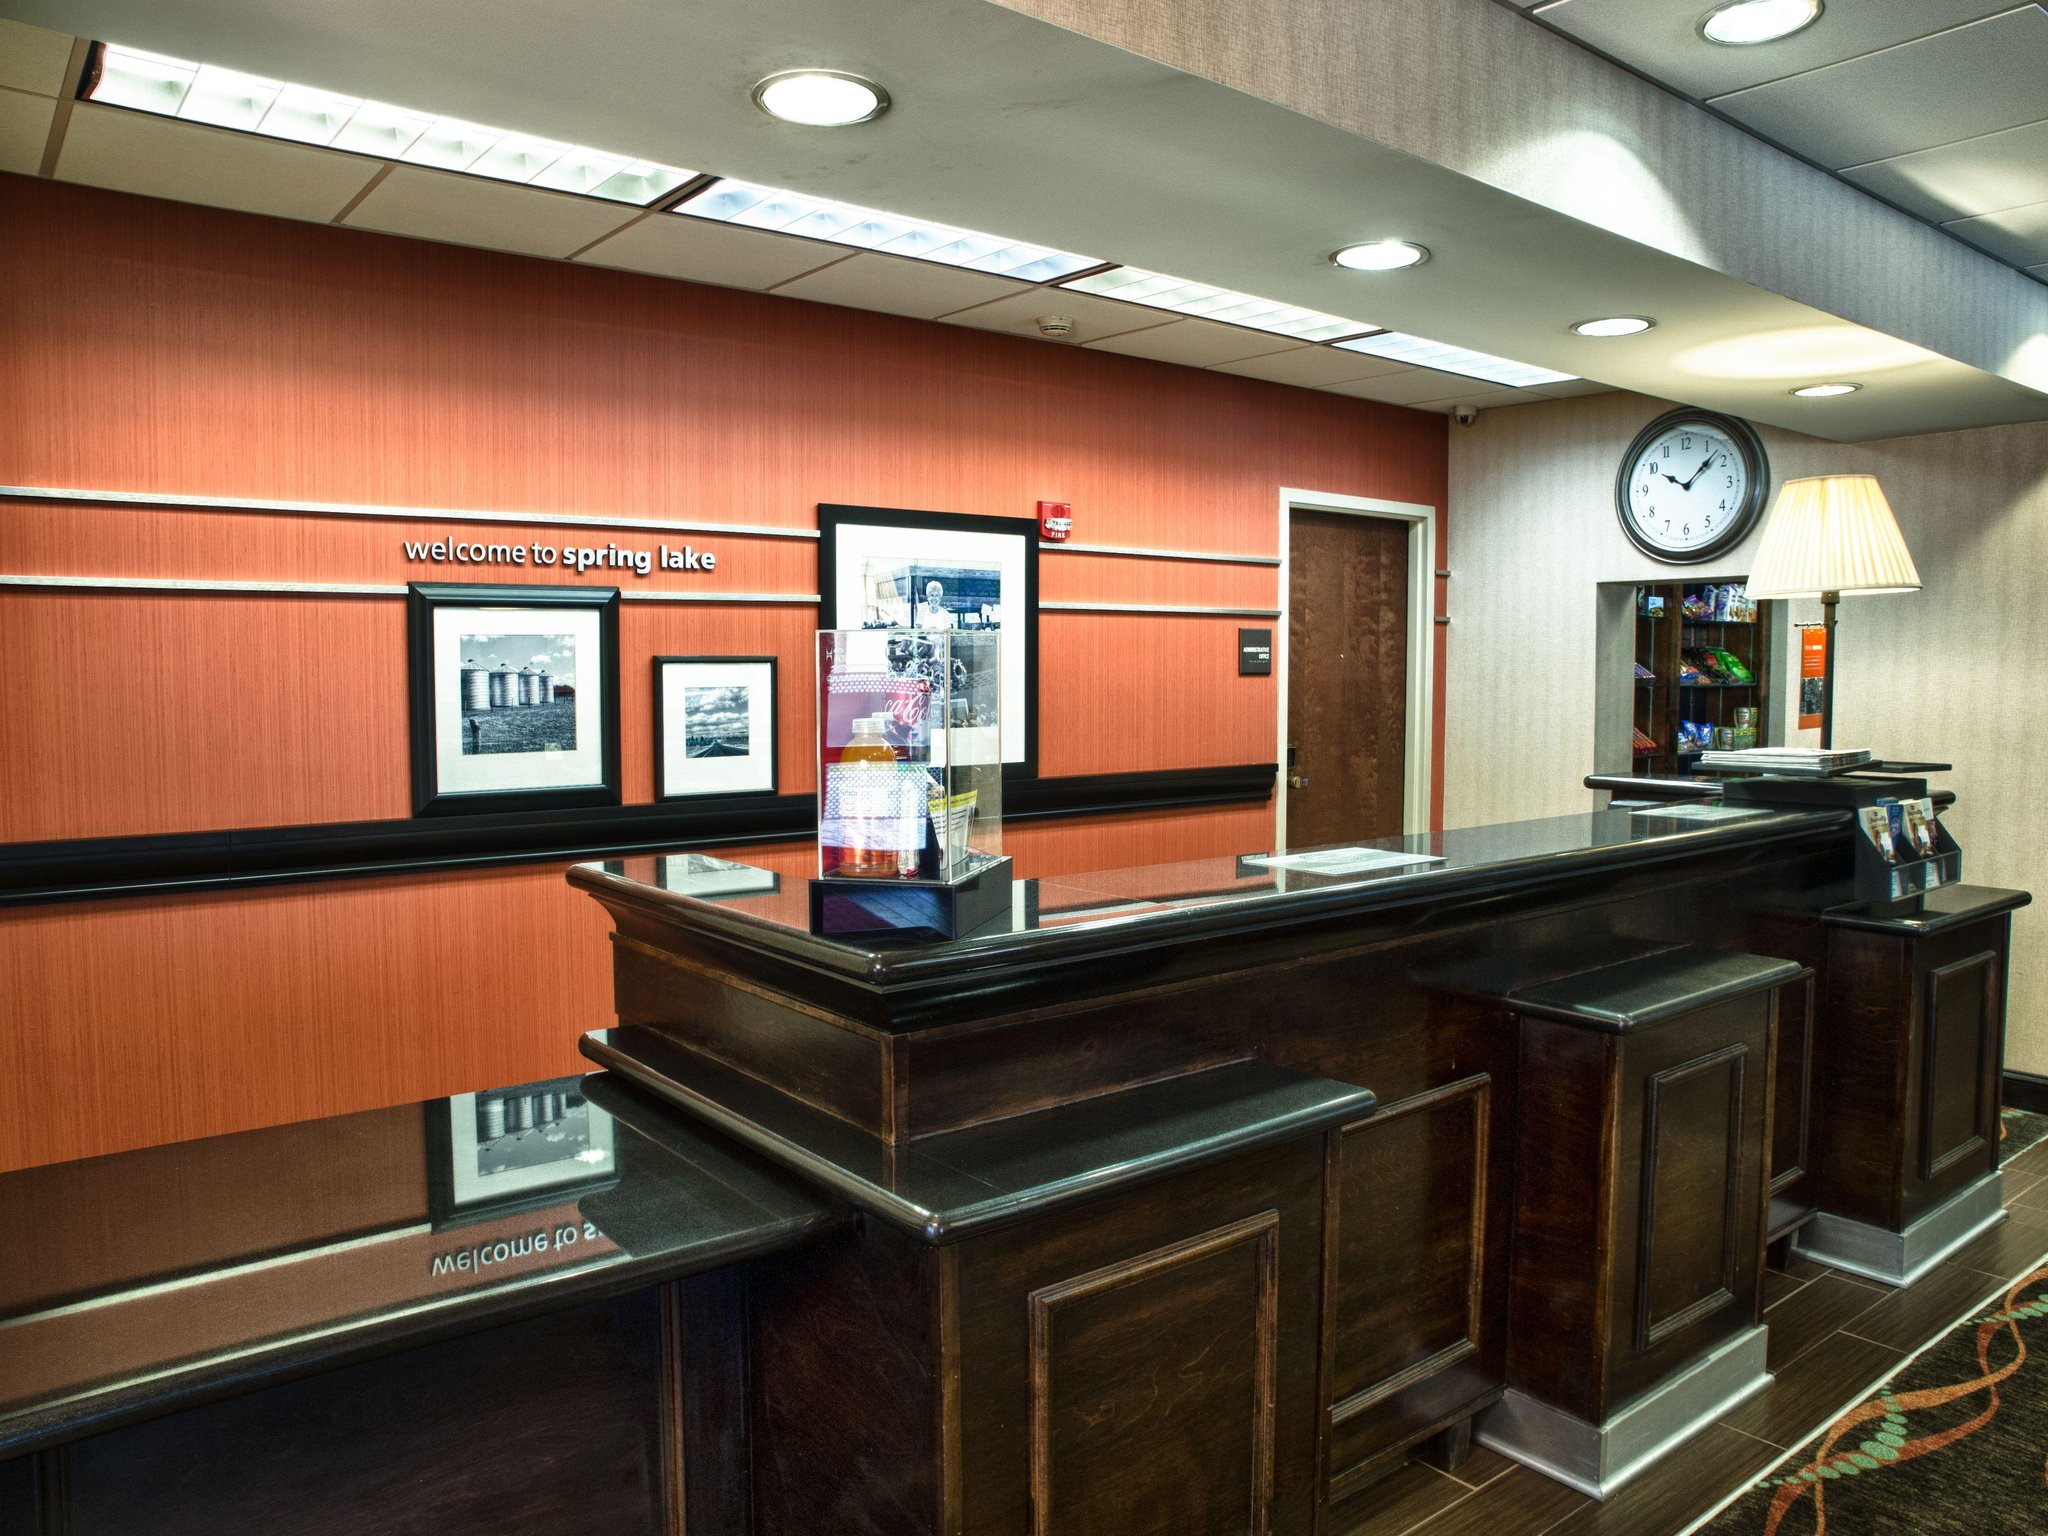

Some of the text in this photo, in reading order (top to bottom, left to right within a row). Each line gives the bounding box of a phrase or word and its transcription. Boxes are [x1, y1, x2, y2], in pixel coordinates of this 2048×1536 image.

[1681, 437, 1691, 450] 12
[1705, 440, 1709, 452] 1
[1663, 445, 1670, 458] 11
[1720, 455, 1727, 468] 2
[1649, 462, 1658, 475] 10
[1726, 476, 1733, 488] 3
[1642, 484, 1649, 497] 9
[1719, 499, 1726, 511] 4
[1649, 506, 1655, 518] 8
[1664, 519, 1671, 532] 7
[1704, 515, 1711, 528] 5
[1051, 531, 1066, 539] FIRE
[1683, 522, 1690, 535] 6
[404, 535, 716, 575] welcome to spring lake
